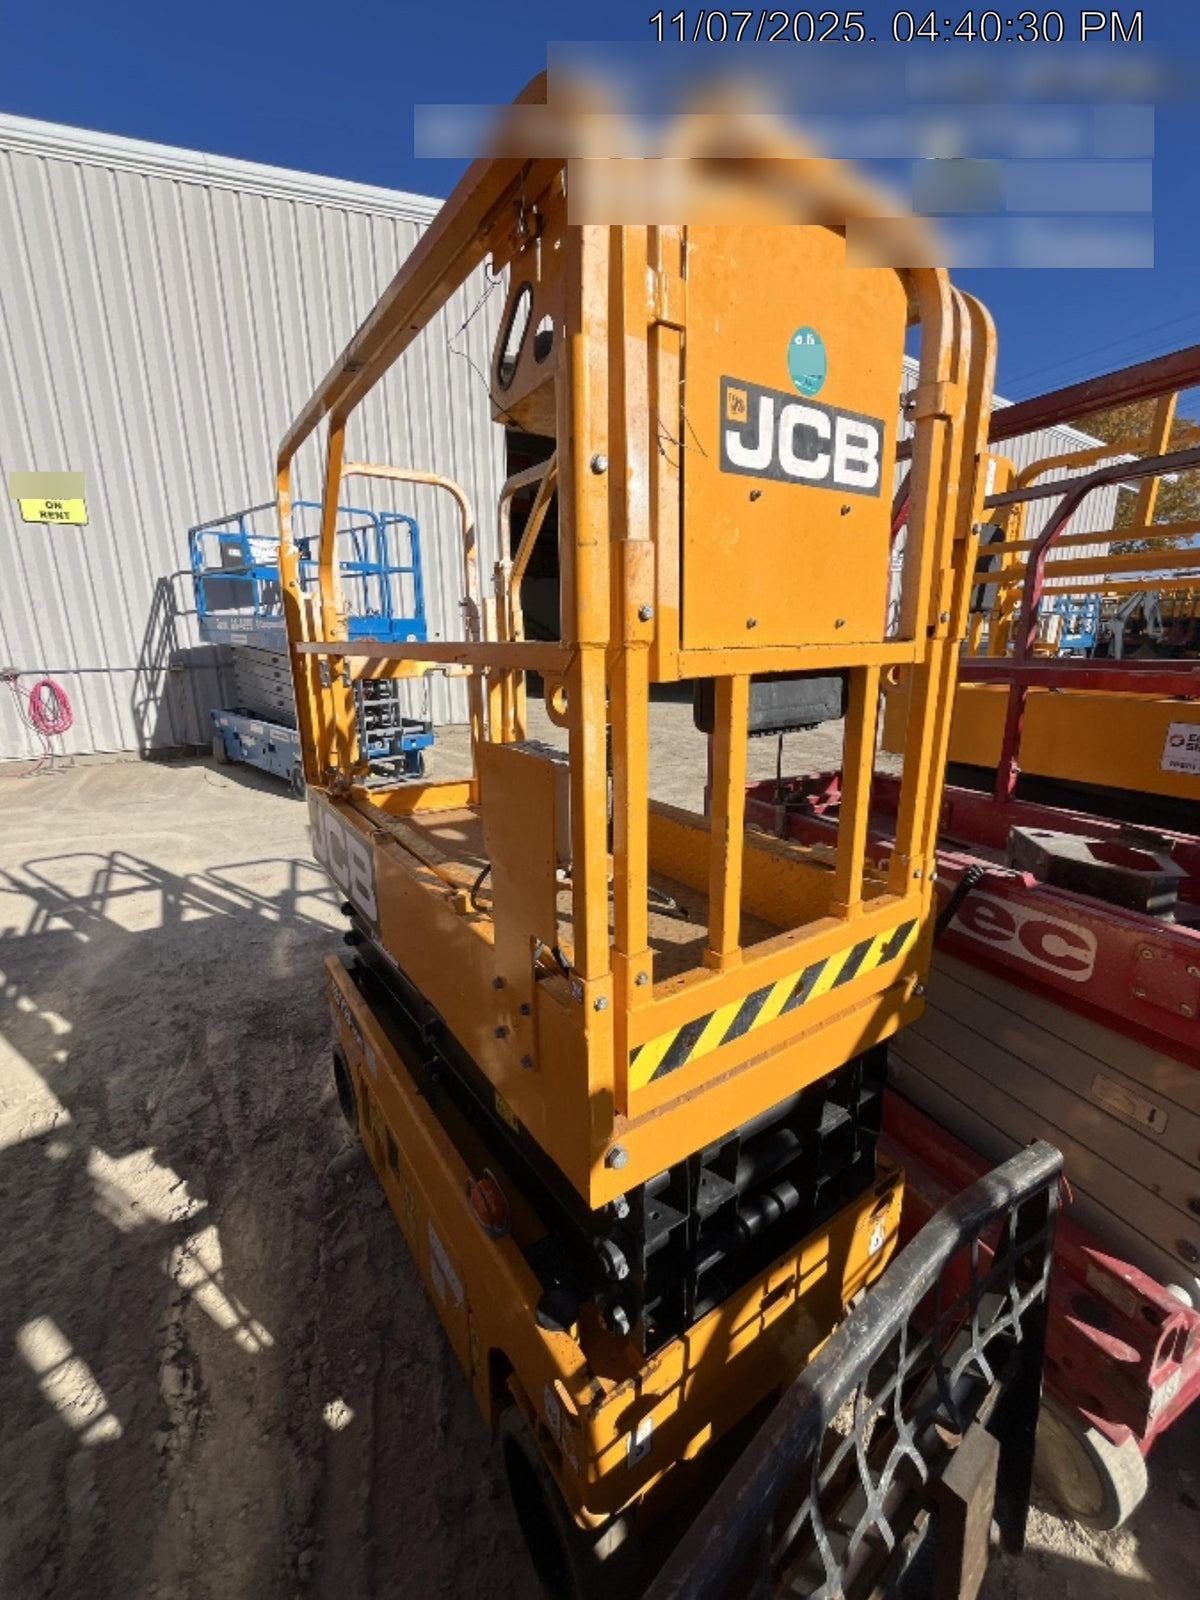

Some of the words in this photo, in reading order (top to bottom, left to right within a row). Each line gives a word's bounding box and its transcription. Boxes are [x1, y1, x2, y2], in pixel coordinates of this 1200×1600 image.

[725, 395, 880, 488] JCB
[311, 799, 378, 922] JCB
[935, 881, 1092, 973] ec
